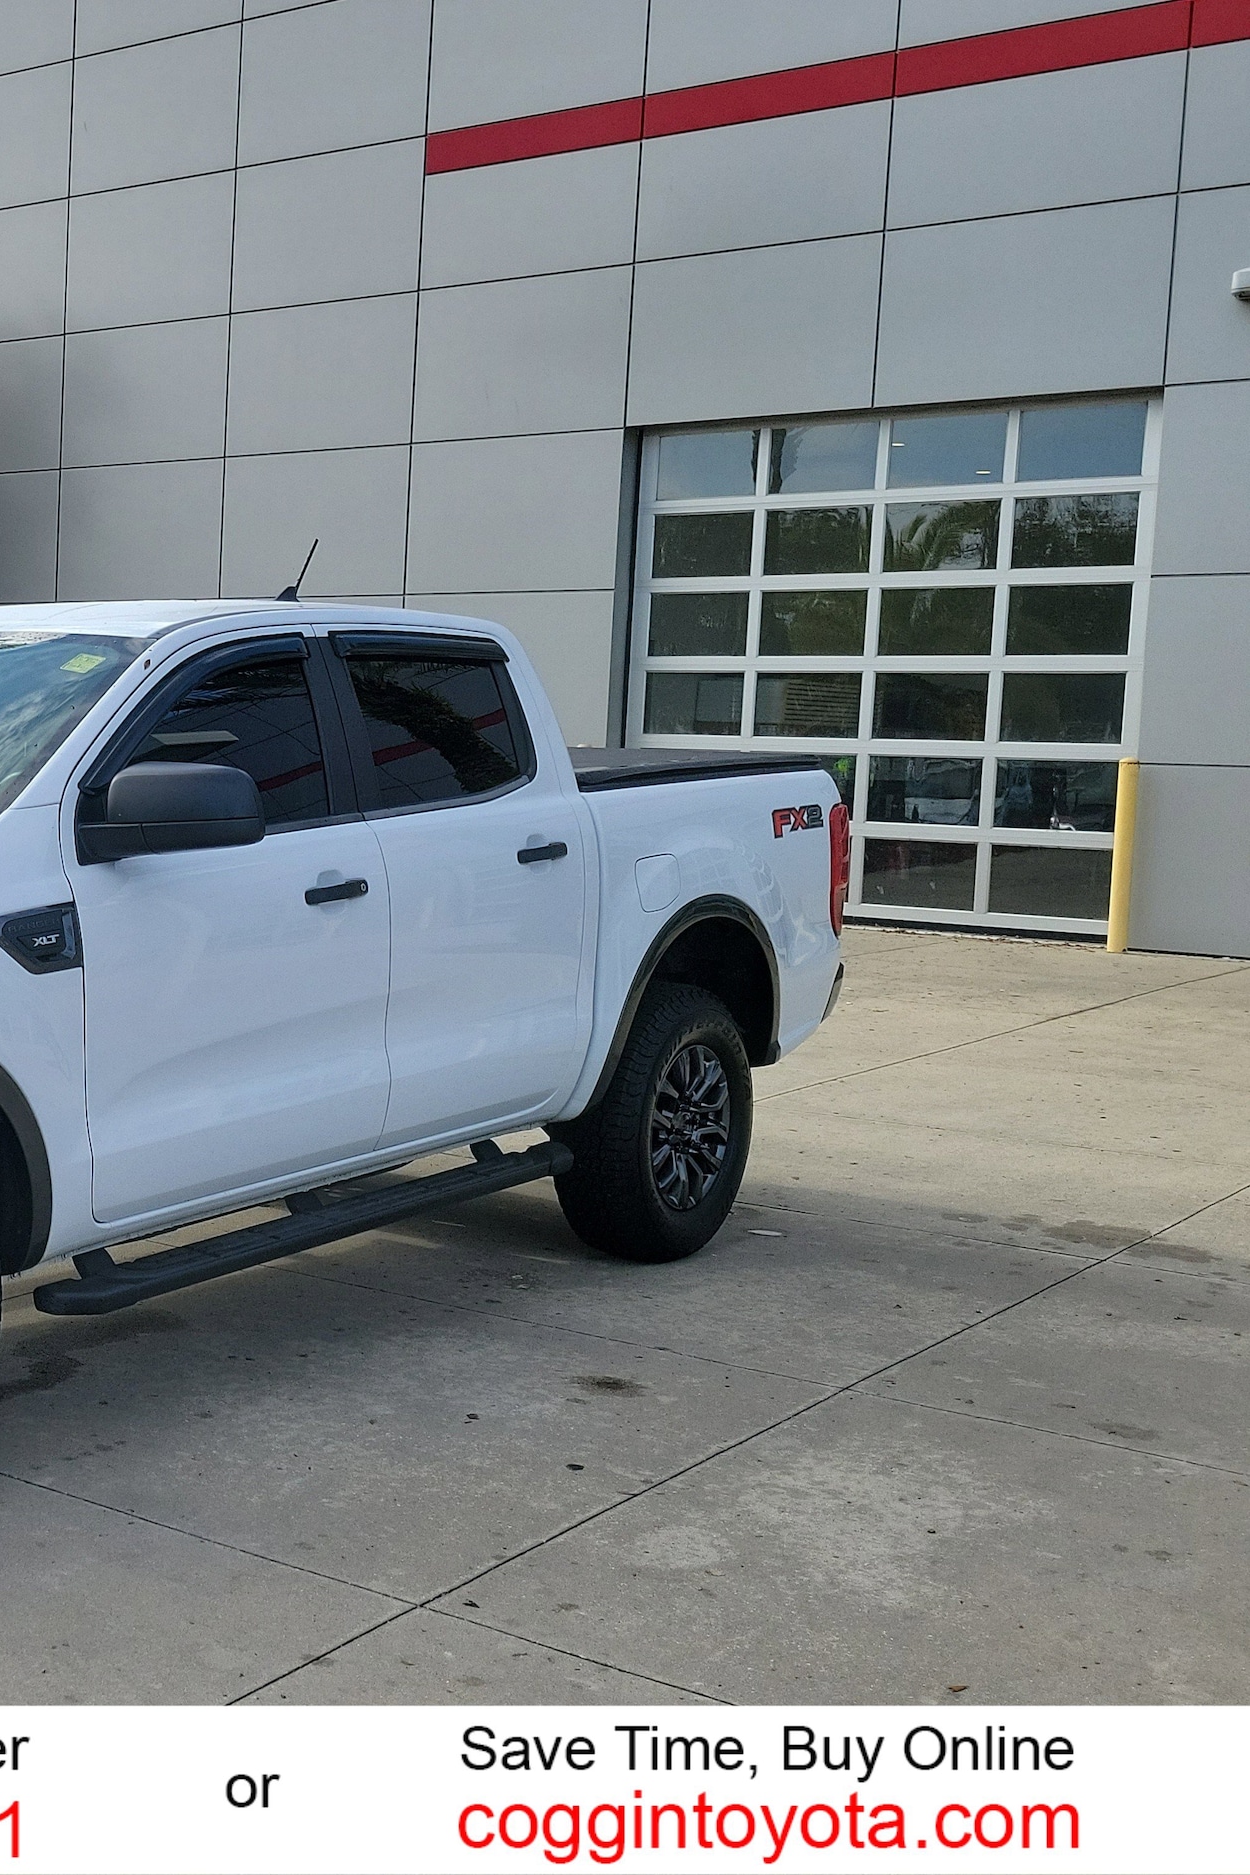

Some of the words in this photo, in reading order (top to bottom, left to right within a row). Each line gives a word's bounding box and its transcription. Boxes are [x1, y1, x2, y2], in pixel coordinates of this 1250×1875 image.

[772, 803, 824, 839] FX2
[7, 917, 61, 933] RANGER
[31, 933, 60, 947] XLT
